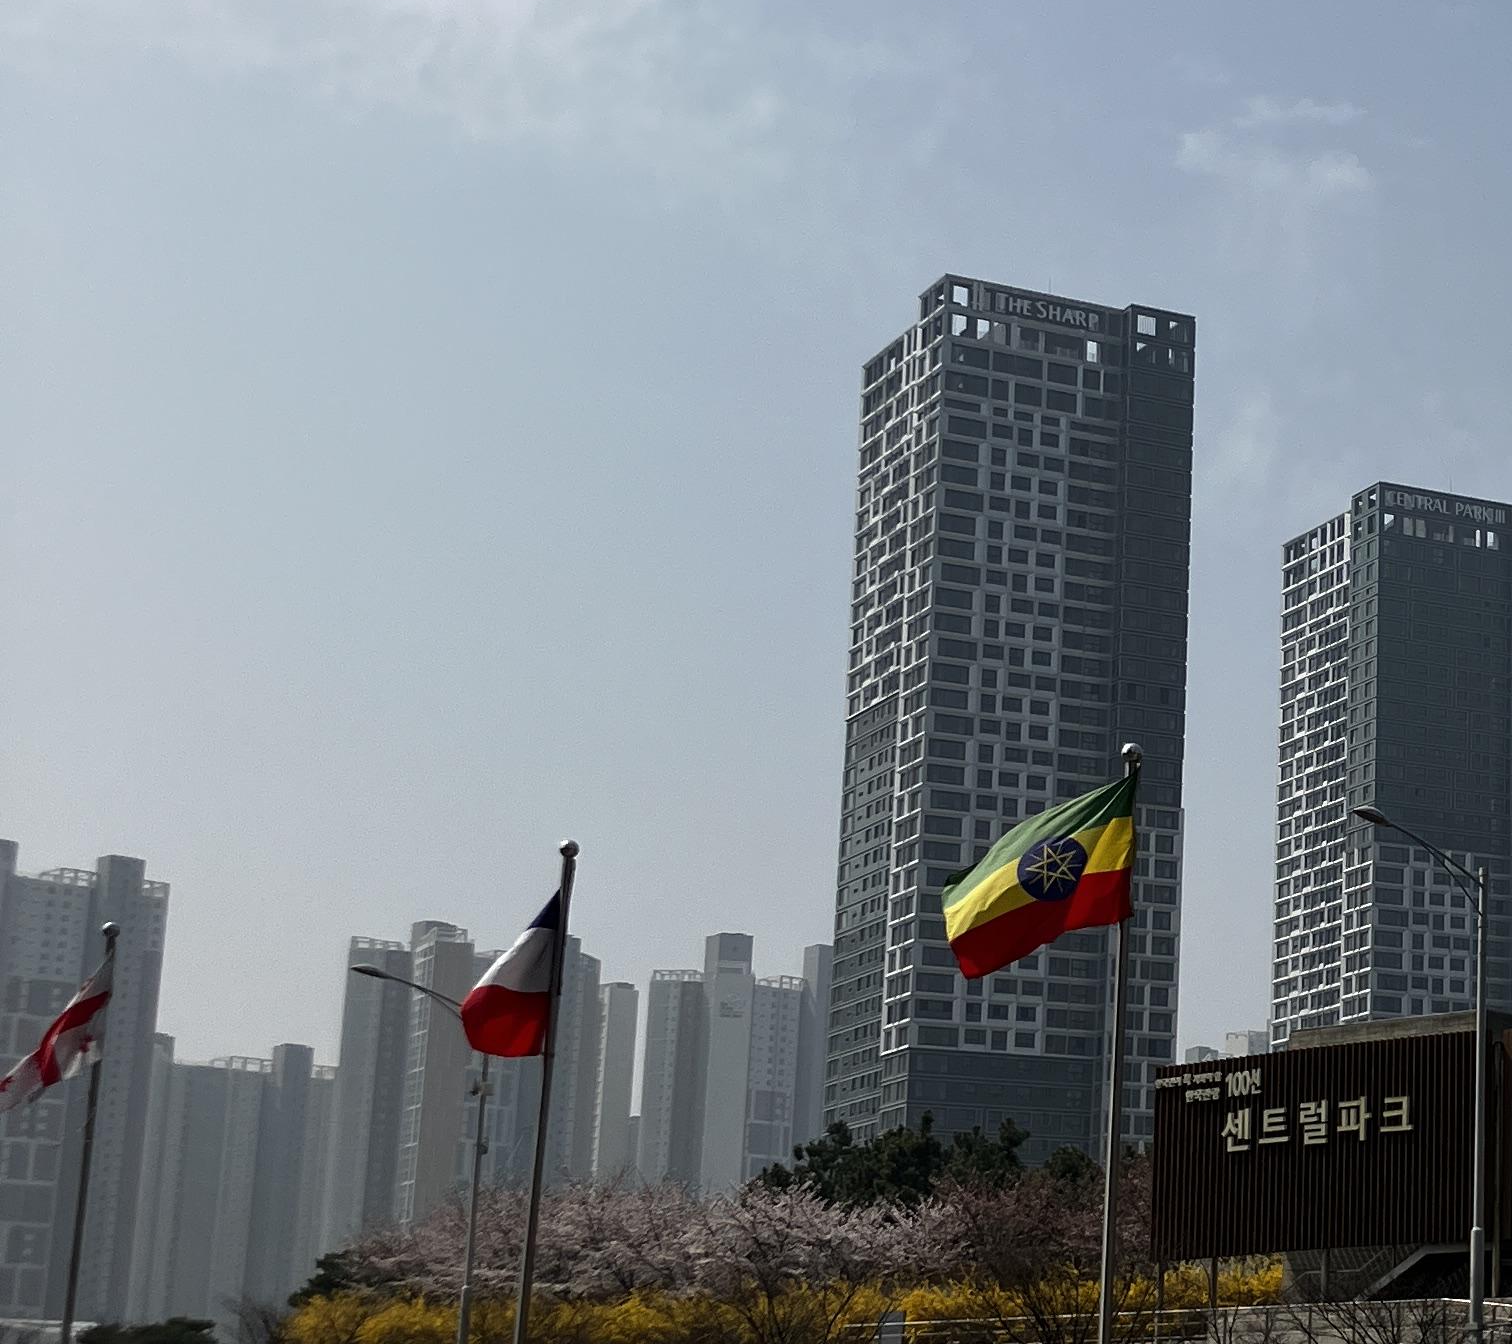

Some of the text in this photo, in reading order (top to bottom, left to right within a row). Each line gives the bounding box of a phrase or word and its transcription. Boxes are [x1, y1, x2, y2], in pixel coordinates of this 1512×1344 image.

[995, 291, 1100, 331] THE SHARP
[1384, 489, 1451, 515] CENTRAL
[1454, 502, 1491, 524] PARK
[1225, 1068, 1263, 1097] 100선
[1221, 1096, 1414, 1152] 센트럴파크
